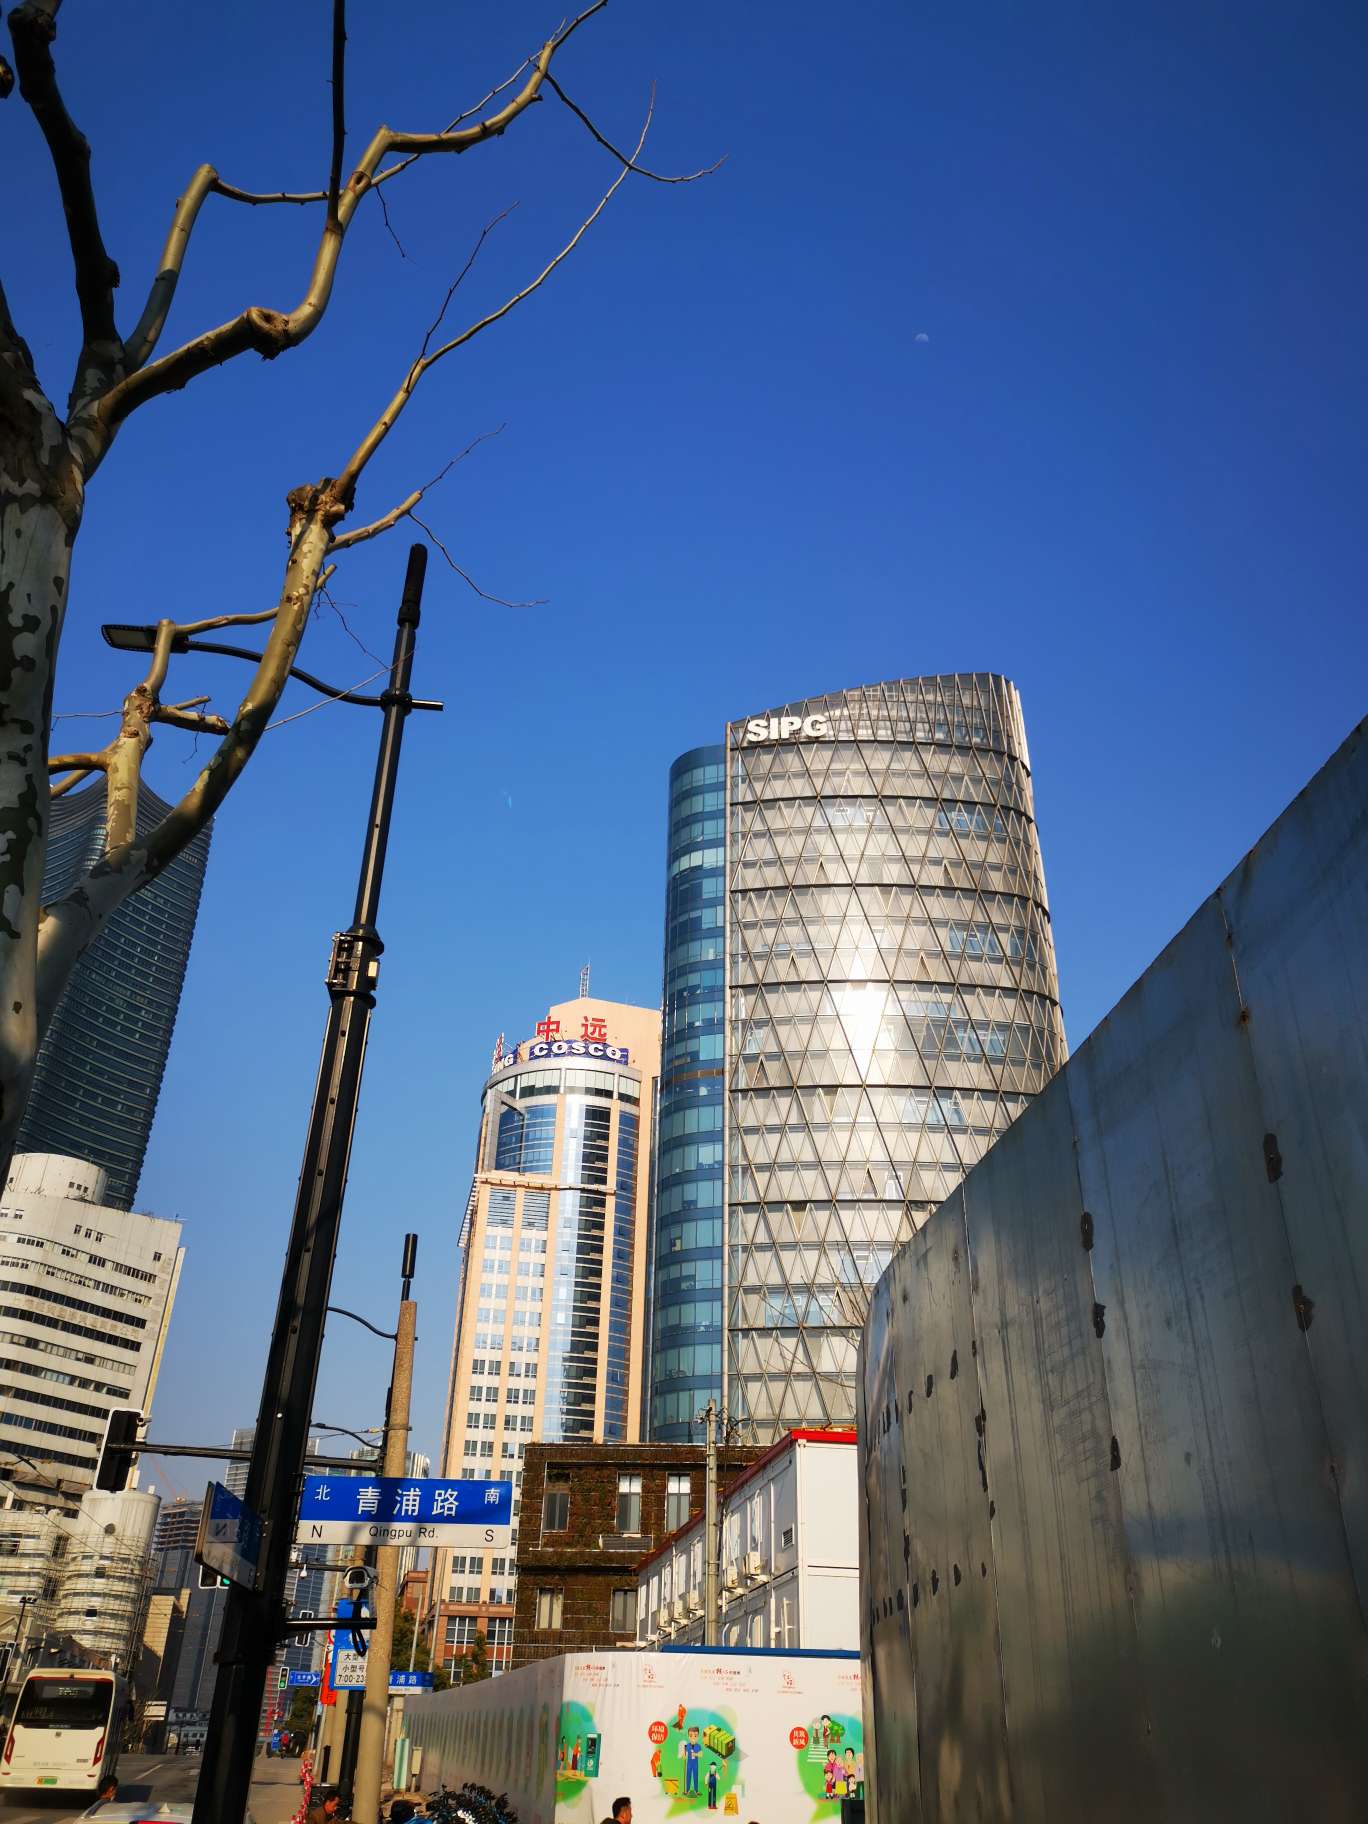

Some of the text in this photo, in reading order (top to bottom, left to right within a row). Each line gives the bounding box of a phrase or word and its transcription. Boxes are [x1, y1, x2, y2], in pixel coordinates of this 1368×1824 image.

[746, 714, 828, 742] SIPG
[536, 1015, 608, 1042] 中远
[533, 1041, 621, 1060] COSCO
[314, 1484, 500, 1517] 北 青浦路 南
[310, 1524, 495, 1543] N Qingpu Rd. S
[338, 1674, 367, 1683] 7:00-23
